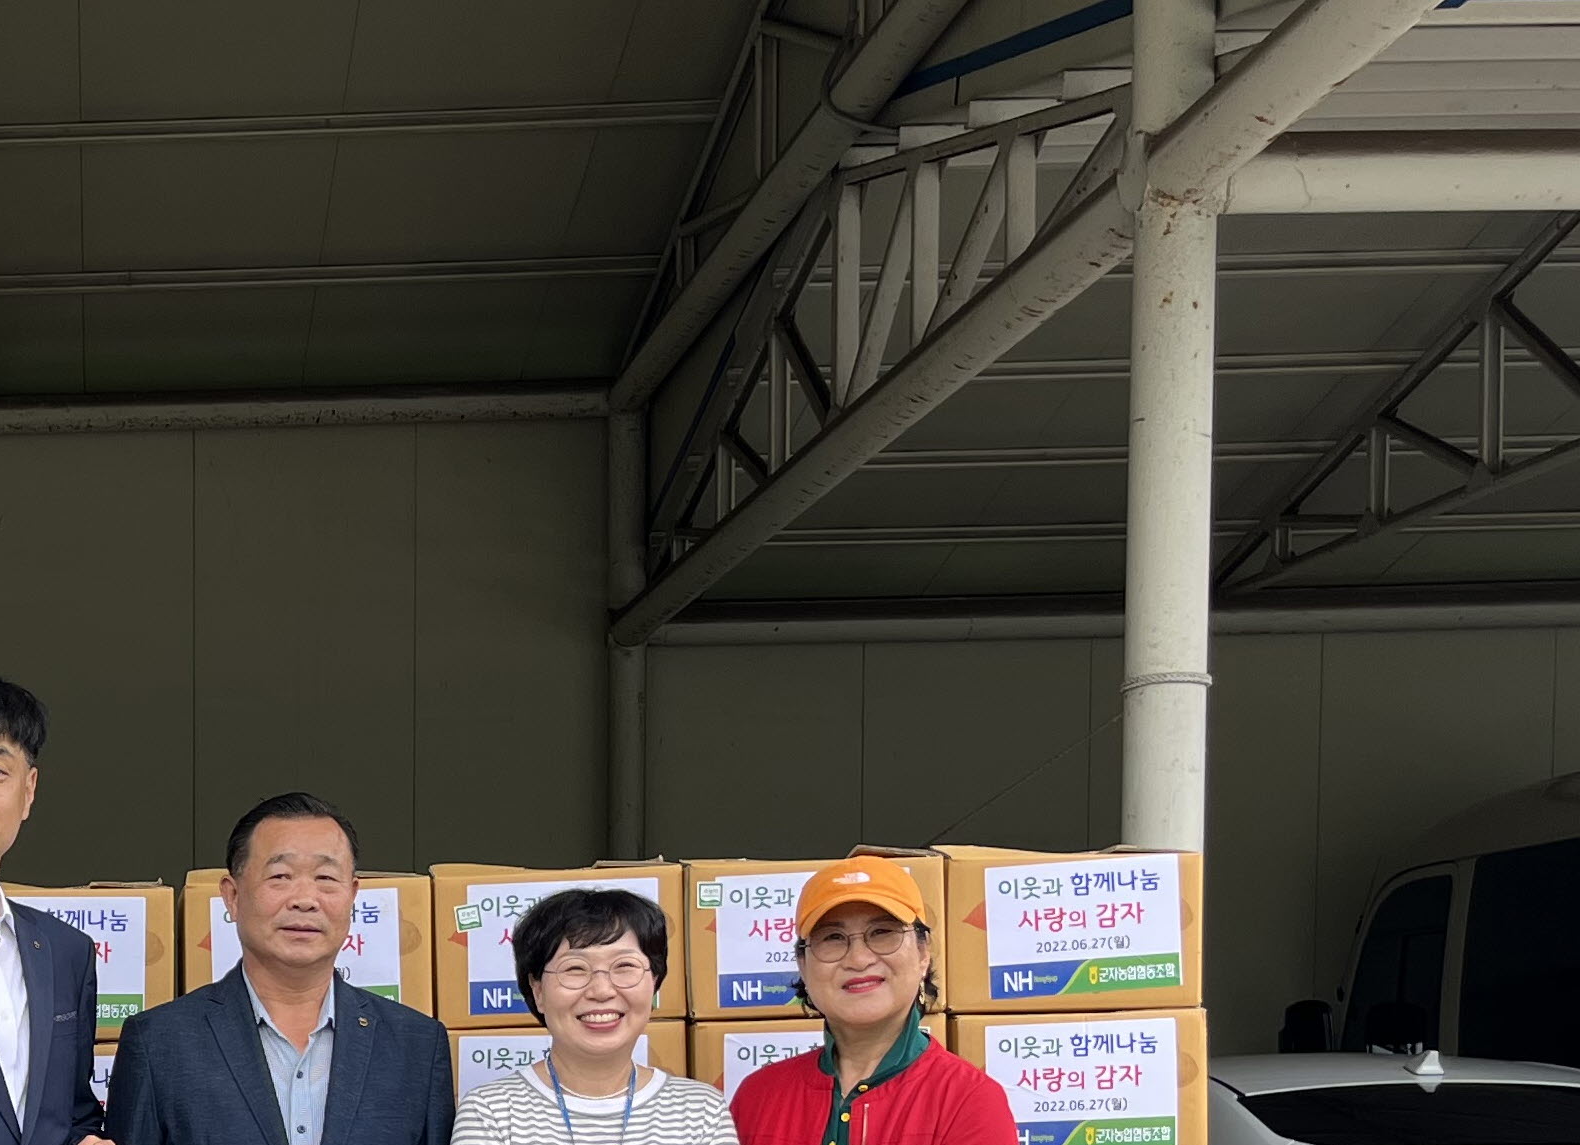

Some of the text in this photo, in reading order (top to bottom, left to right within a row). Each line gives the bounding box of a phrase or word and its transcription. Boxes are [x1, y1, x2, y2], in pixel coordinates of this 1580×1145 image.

[999, 869, 1160, 900] 이웃과 함께나눔
[730, 886, 795, 910] 이웃과
[1018, 903, 1144, 932] 사랑의 감자
[1036, 935, 1130, 953] 2022.06.27(월)
[733, 980, 762, 1001] NH
[1003, 971, 1033, 992] NH
[483, 988, 512, 1008] NH
[999, 1032, 1158, 1059] 이웃과 함께나눔
[472, 1047, 535, 1070] 이웃과
[1017, 1065, 1142, 1093] 사랑의 감자
[1034, 1097, 1128, 1113] 2022.06.27(월)
